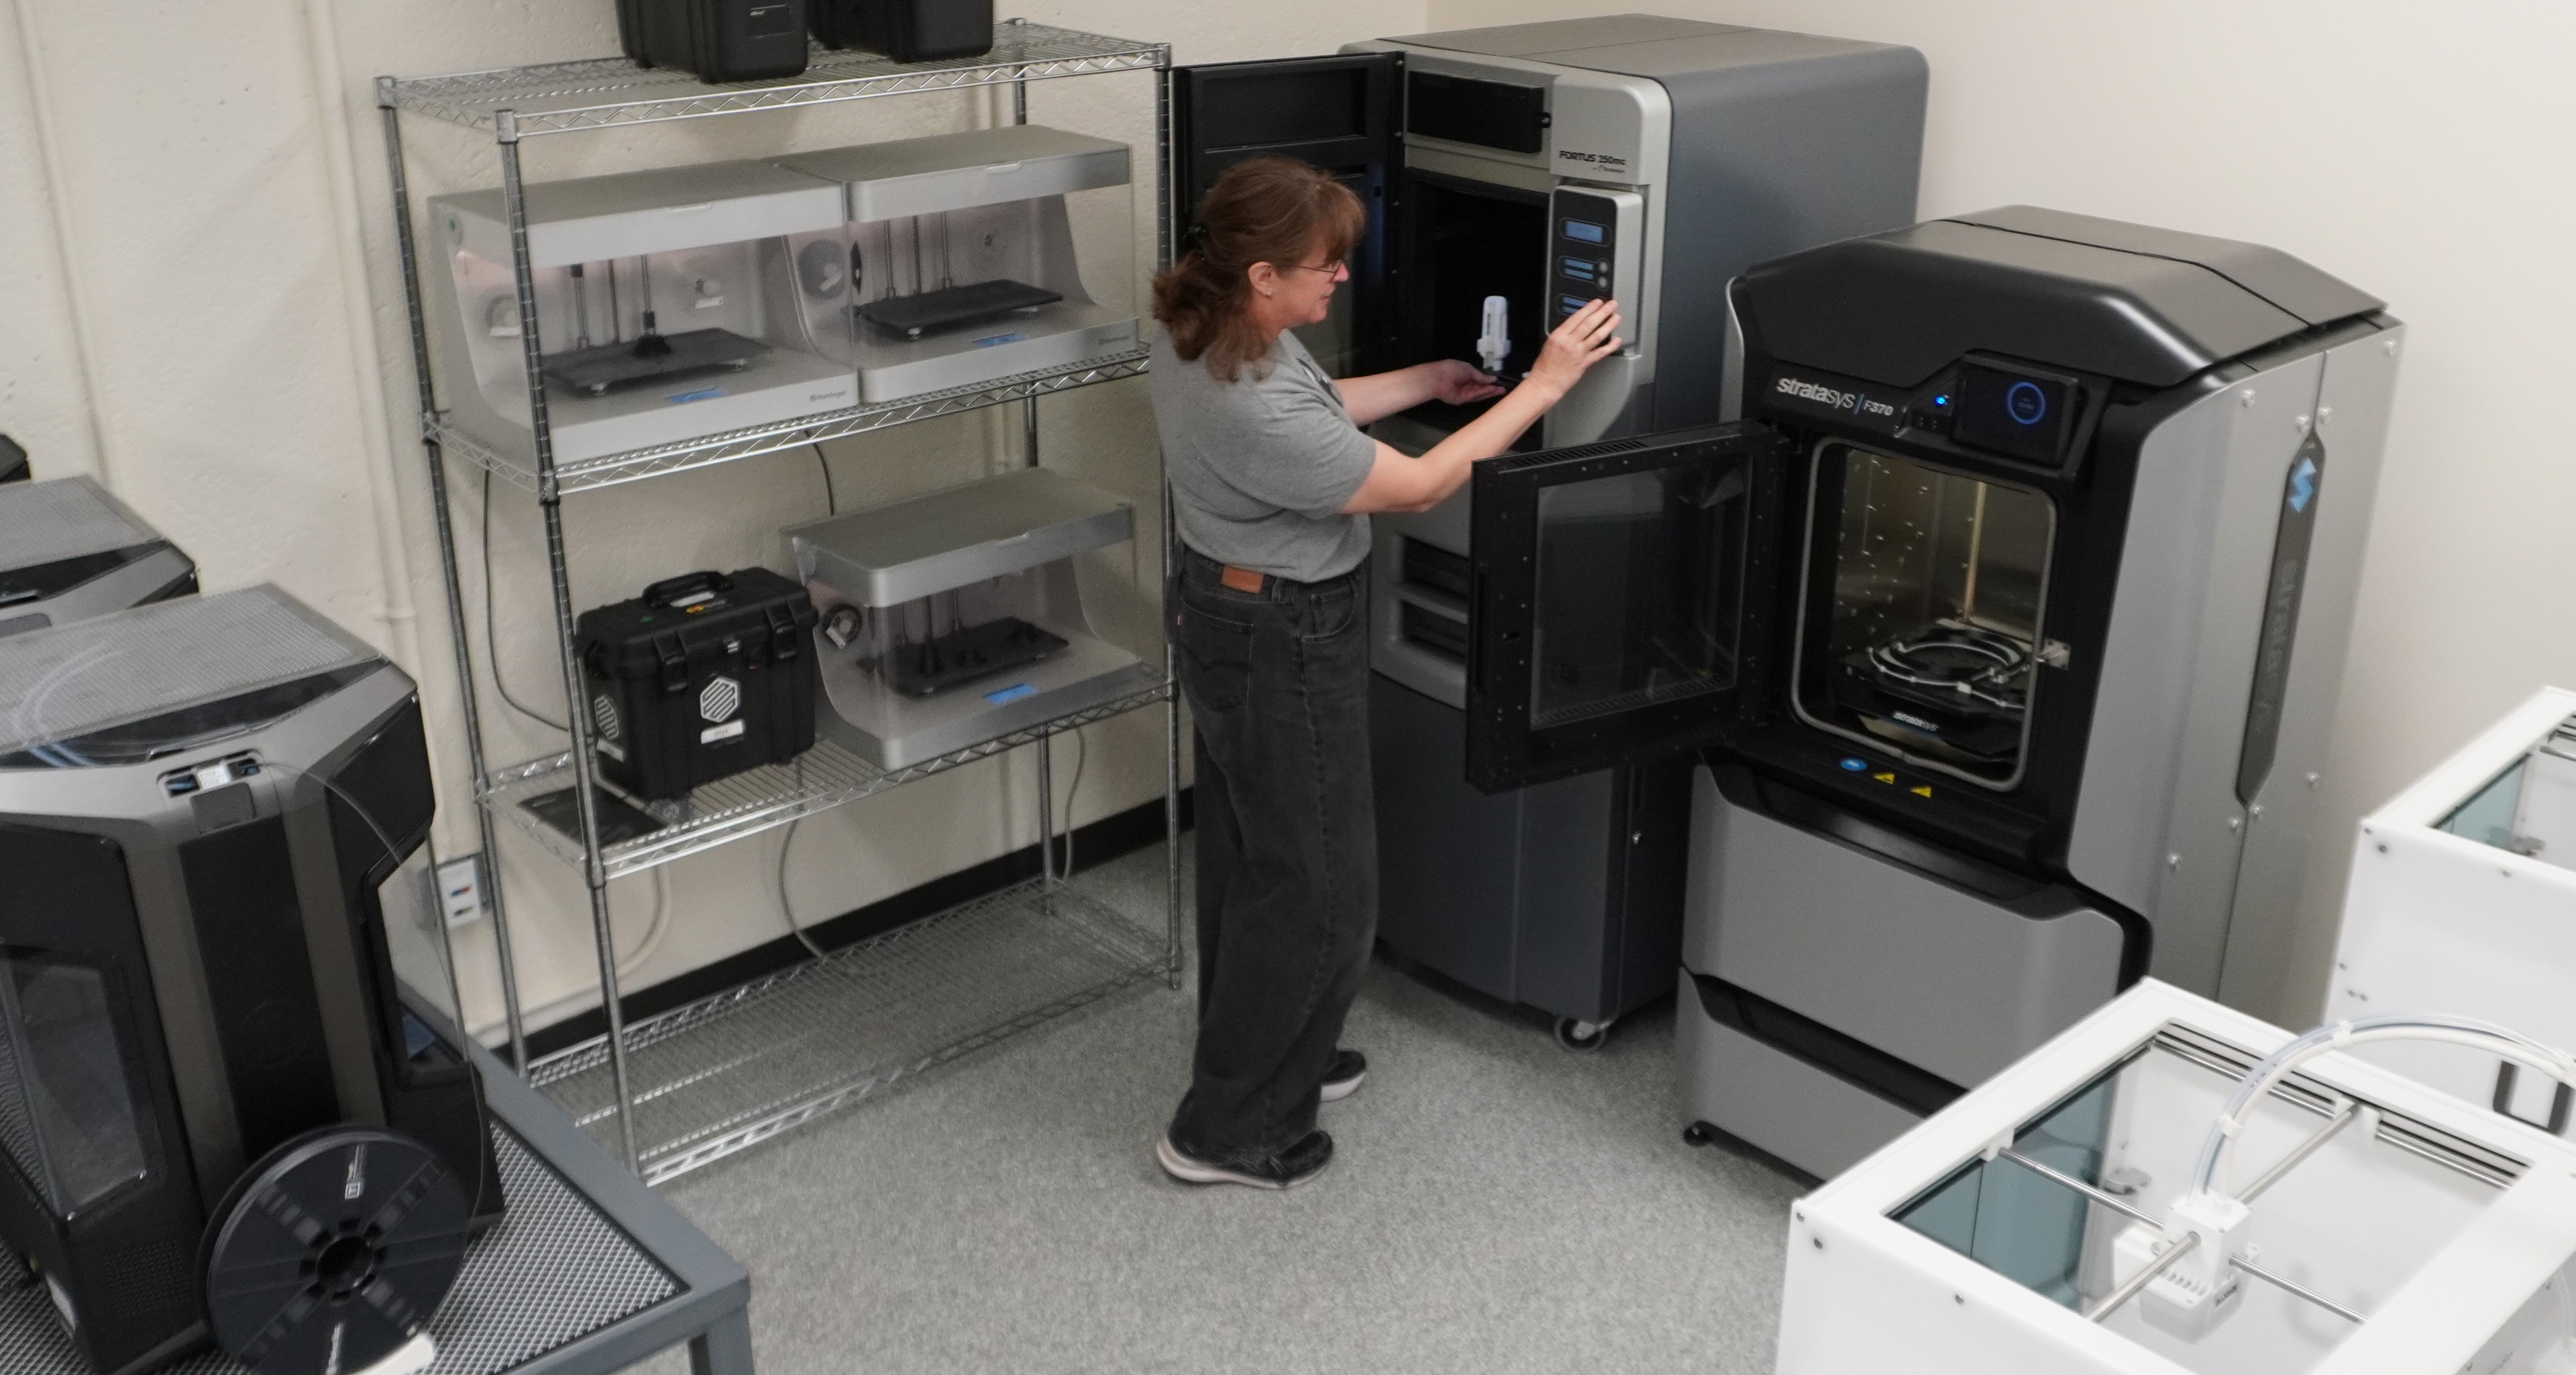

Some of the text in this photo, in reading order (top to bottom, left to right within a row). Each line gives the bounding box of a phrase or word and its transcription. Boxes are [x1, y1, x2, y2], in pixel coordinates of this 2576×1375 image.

[1560, 150, 1597, 162] FORTUS
[1777, 378, 1894, 416] stratasys F370
[1893, 711, 1939, 732] stratasys
